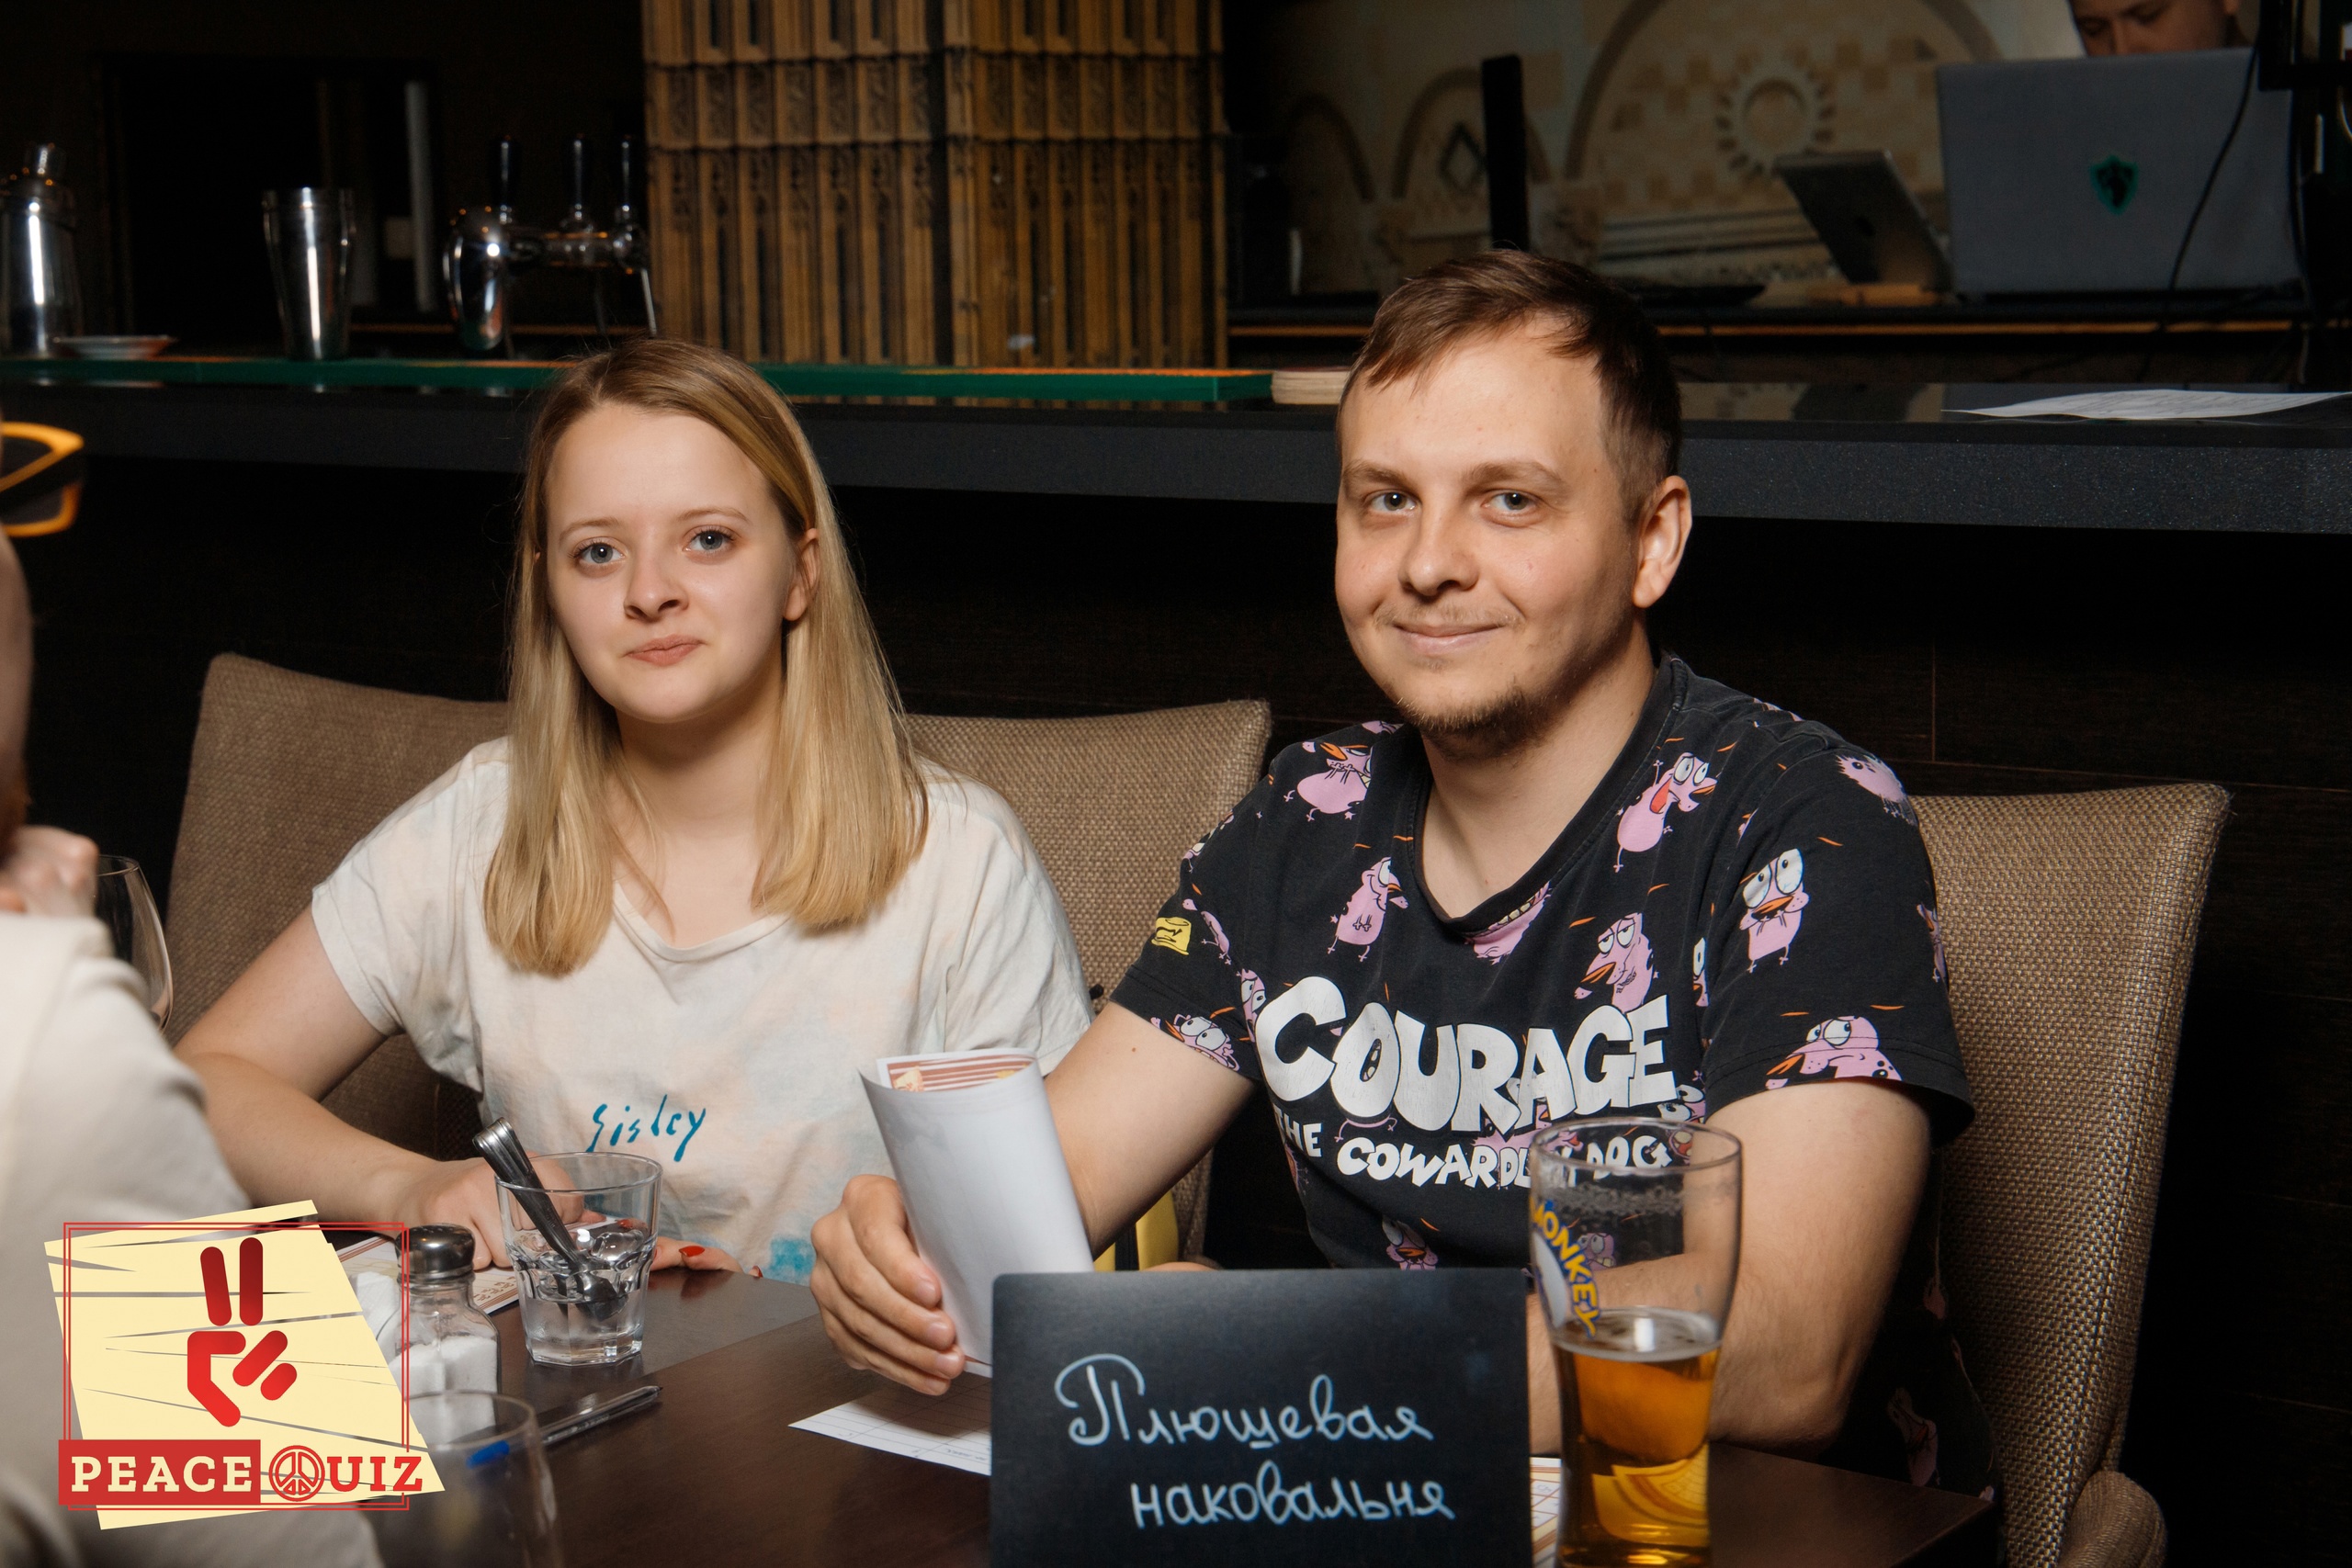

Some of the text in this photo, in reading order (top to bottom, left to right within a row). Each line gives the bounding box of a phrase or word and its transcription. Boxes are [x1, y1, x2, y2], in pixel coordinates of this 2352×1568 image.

[1256, 976, 1677, 1134] COURAGE
[1586, 1134, 1674, 1180] DOG
[1054, 1353, 1433, 1449] Плющевая
[1130, 1459, 1455, 1529] наковальня
